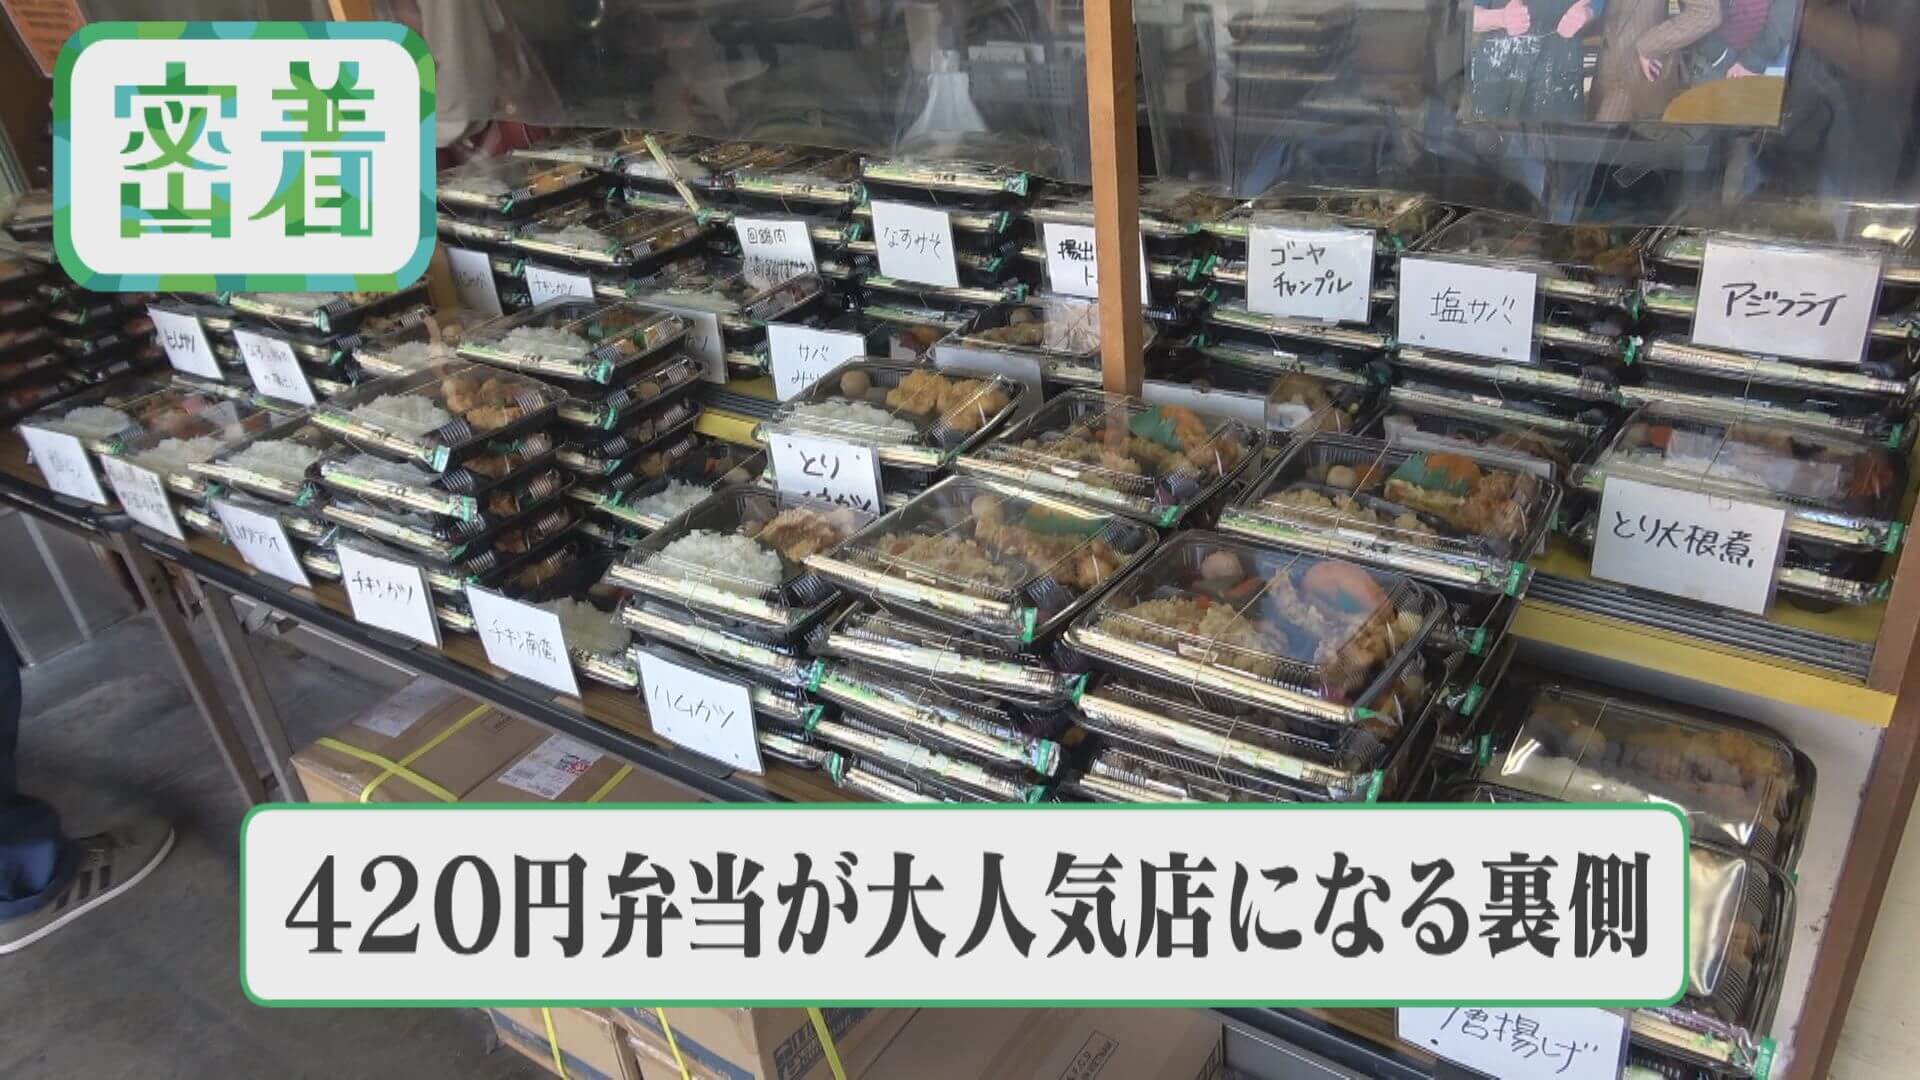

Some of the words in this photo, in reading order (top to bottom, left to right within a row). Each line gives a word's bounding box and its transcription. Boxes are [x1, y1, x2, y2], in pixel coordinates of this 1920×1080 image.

[884, 227, 944, 259] なすみそ
[1271, 241, 1326, 266] ゴーヤ
[1273, 269, 1352, 297] チャンプル
[1429, 286, 1516, 324] 塩サバ
[1722, 282, 1847, 326] アジフライ
[799, 344, 829, 362] サバ
[800, 450, 840, 480] とり
[1613, 511, 1754, 568] とり大根煮
[488, 619, 557, 663] チキン南蛮
[654, 684, 735, 728] ハムカツ
